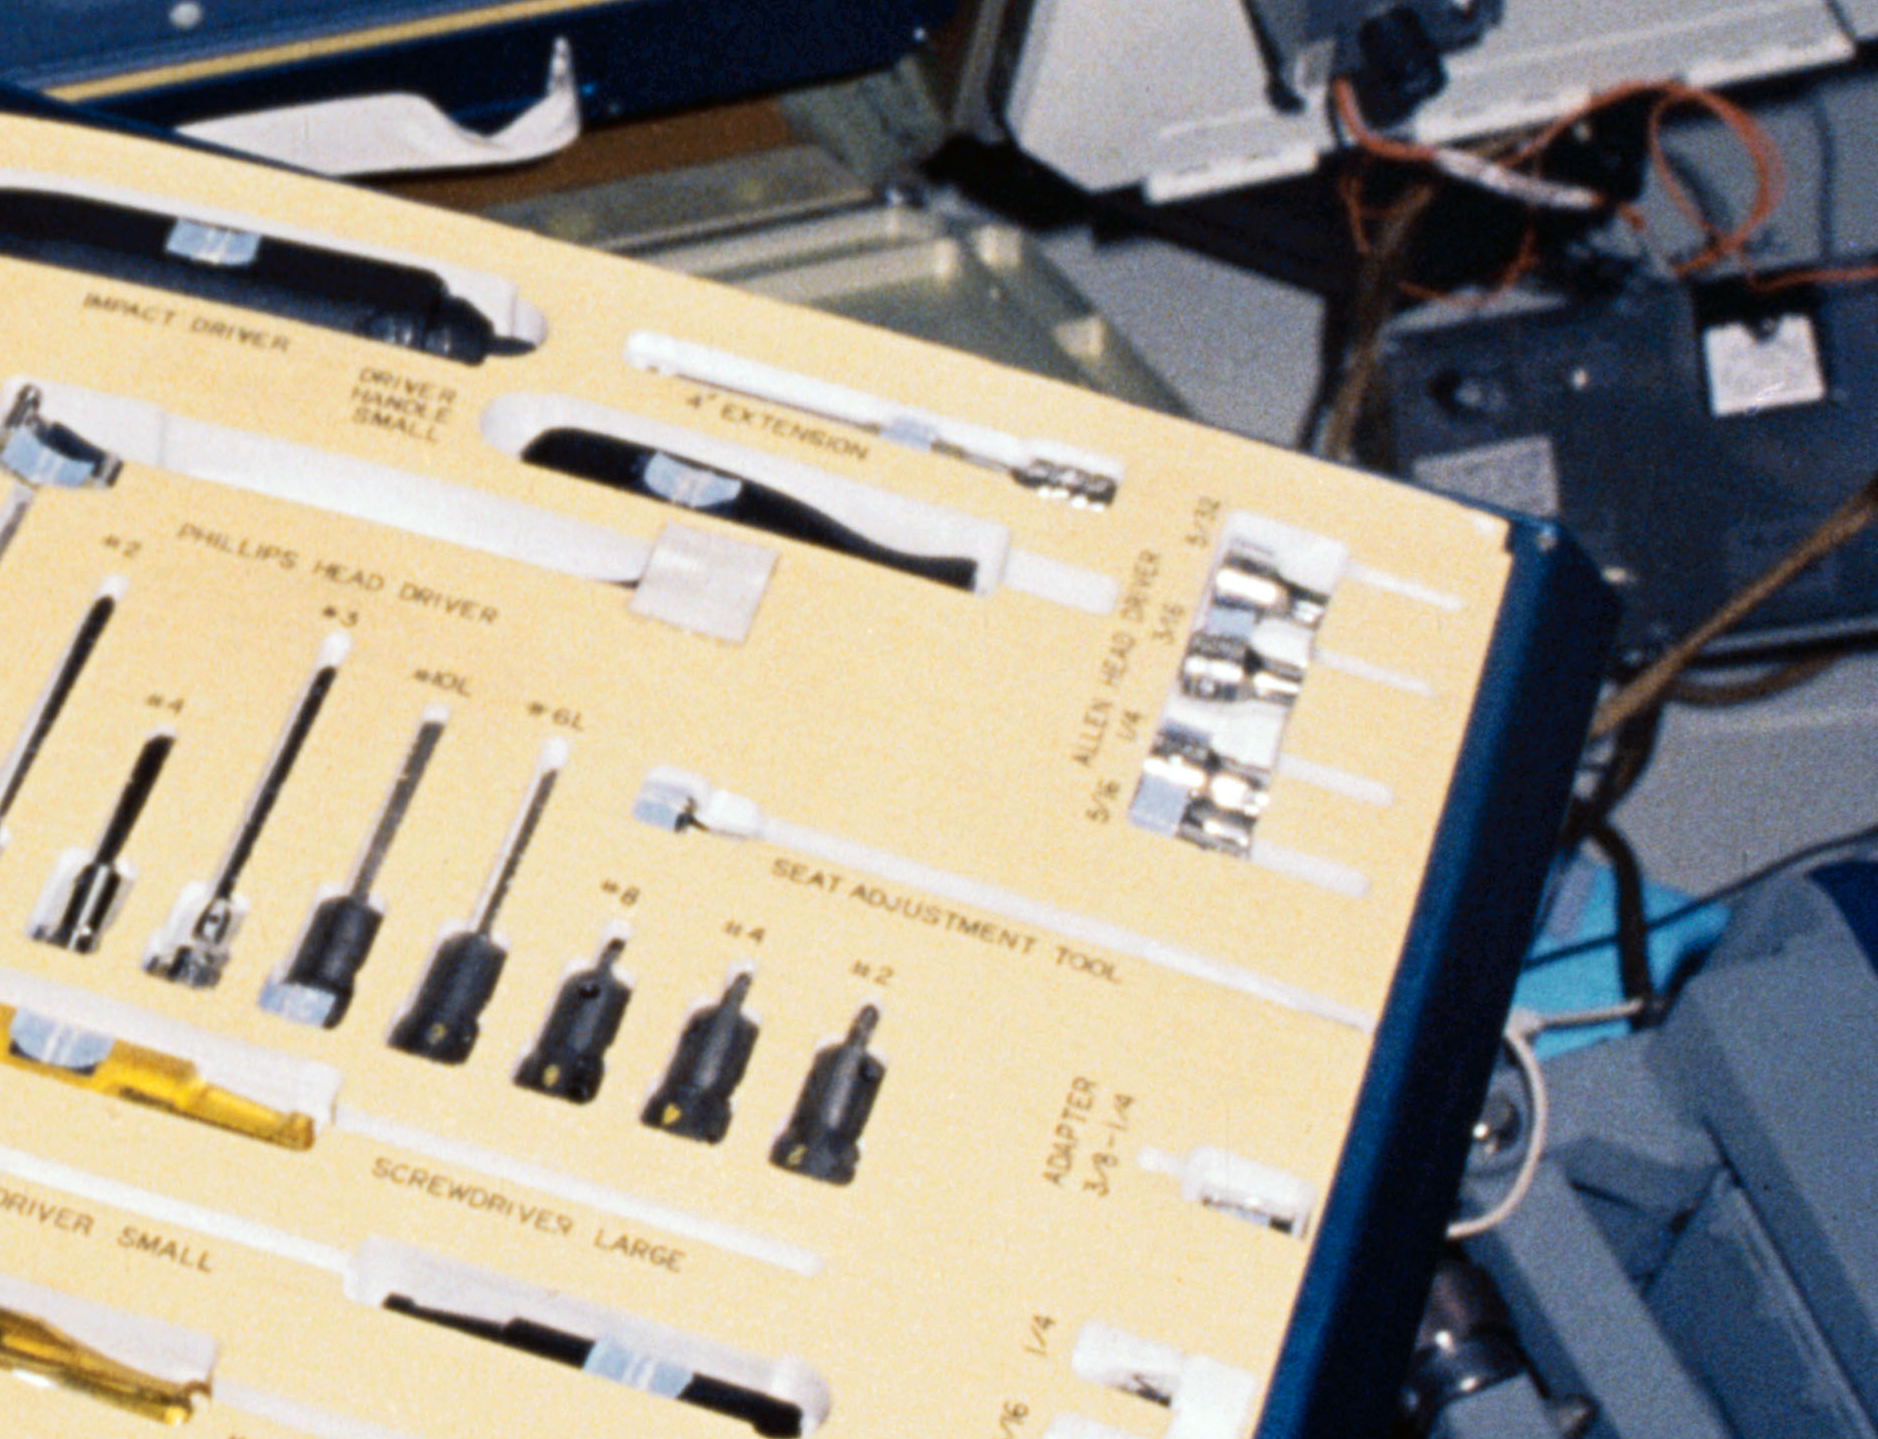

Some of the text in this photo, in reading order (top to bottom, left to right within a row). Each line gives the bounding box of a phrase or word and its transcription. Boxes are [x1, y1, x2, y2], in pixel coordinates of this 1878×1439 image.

[82, 291, 291, 353] IMPACT DRIVER
[350, 386, 453, 424] HANDLE
[358, 366, 458, 405] DRIVER
[352, 407, 440, 444] SMALL
[720, 401, 870, 463] EXTENSION
[176, 522, 499, 626] PHILLIPS HEAD DRIVER
[1073, 548, 1162, 769] ALLEN HEAD DRIVER
[770, 855, 1124, 985] SEAT ADJUSTMENT TOOL
[1042, 1074, 1100, 1189] ADAPTER
[370, 1156, 688, 1274] SCREWDRIVER LARGE
[115, 1222, 217, 1275] SMALL
[1021, 1312, 1059, 1358] 1/4
